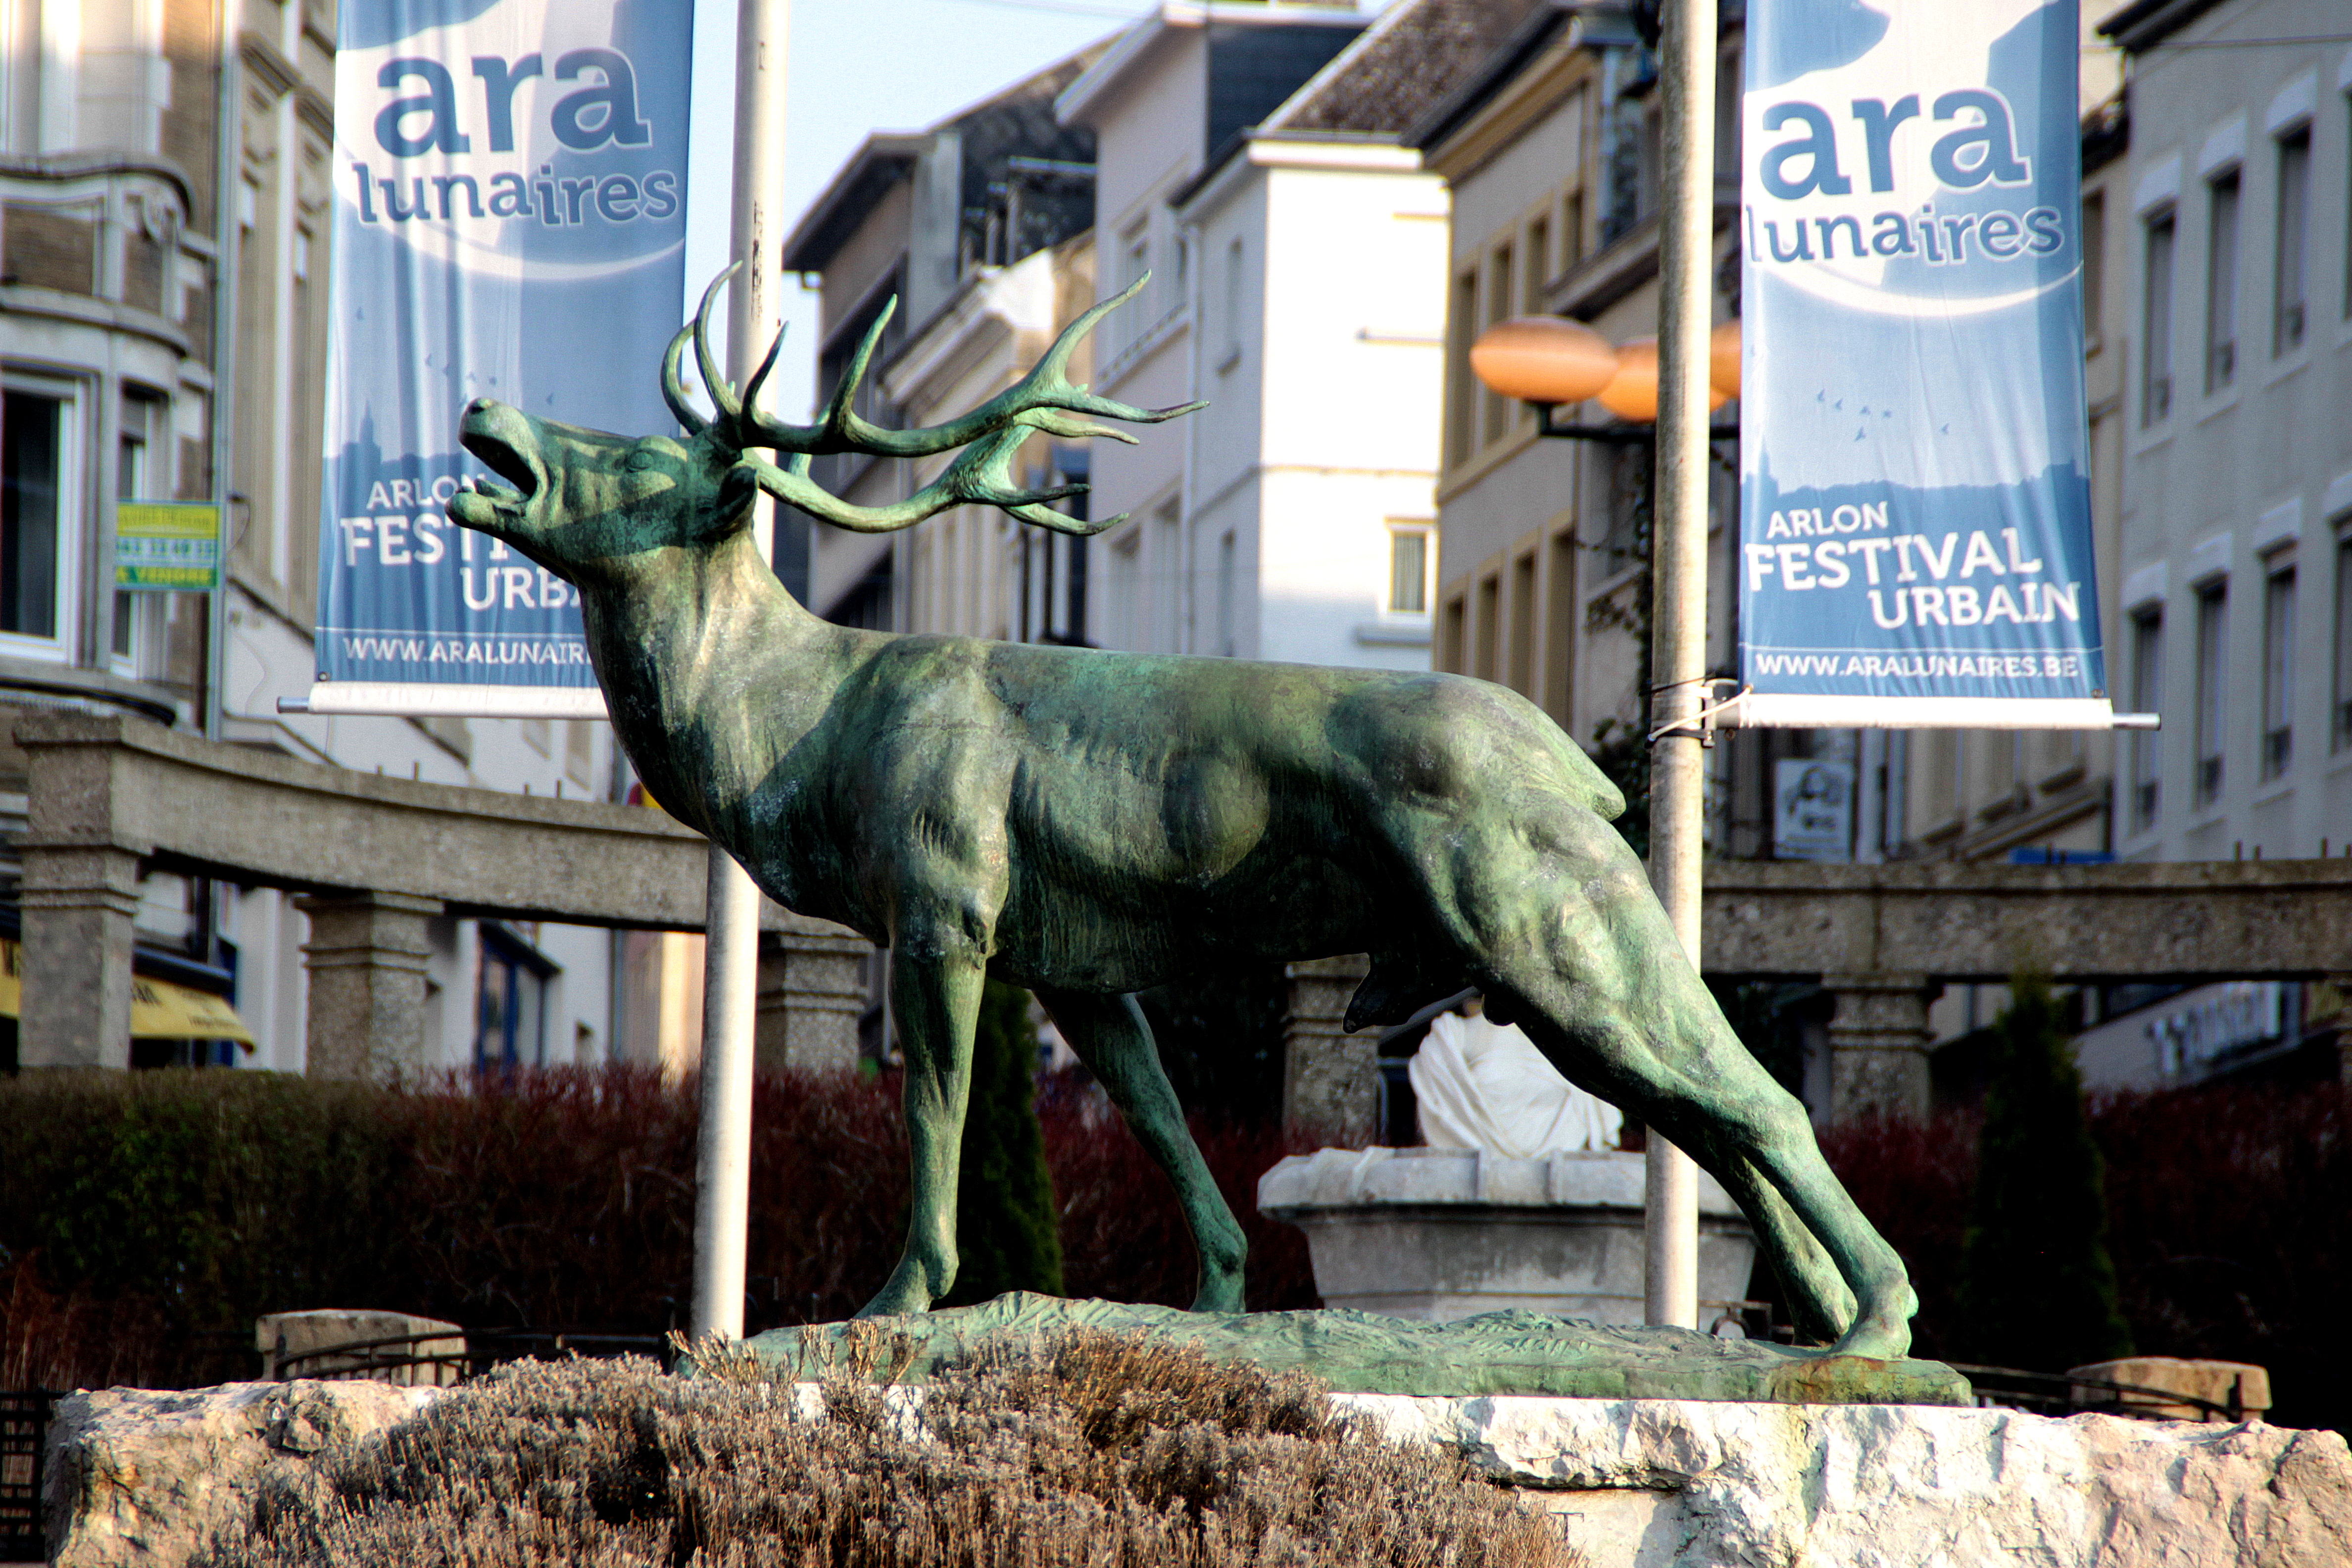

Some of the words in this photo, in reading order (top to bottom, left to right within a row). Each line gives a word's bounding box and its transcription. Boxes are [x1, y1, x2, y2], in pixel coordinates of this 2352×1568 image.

[374, 47, 652, 158] ara
[1760, 87, 2032, 200] ara
[352, 162, 678, 226] lunaires
[1746, 202, 2065, 266] lunaires
[1766, 500, 1889, 539] ARLON
[1745, 527, 2043, 591] FESTIVAL
[1867, 582, 2081, 630] URBAIN
[343, 637, 592, 665] WWW.ARALUNAIR
[1756, 654, 2077, 678] WWW.ARALUNAIRES.BE
